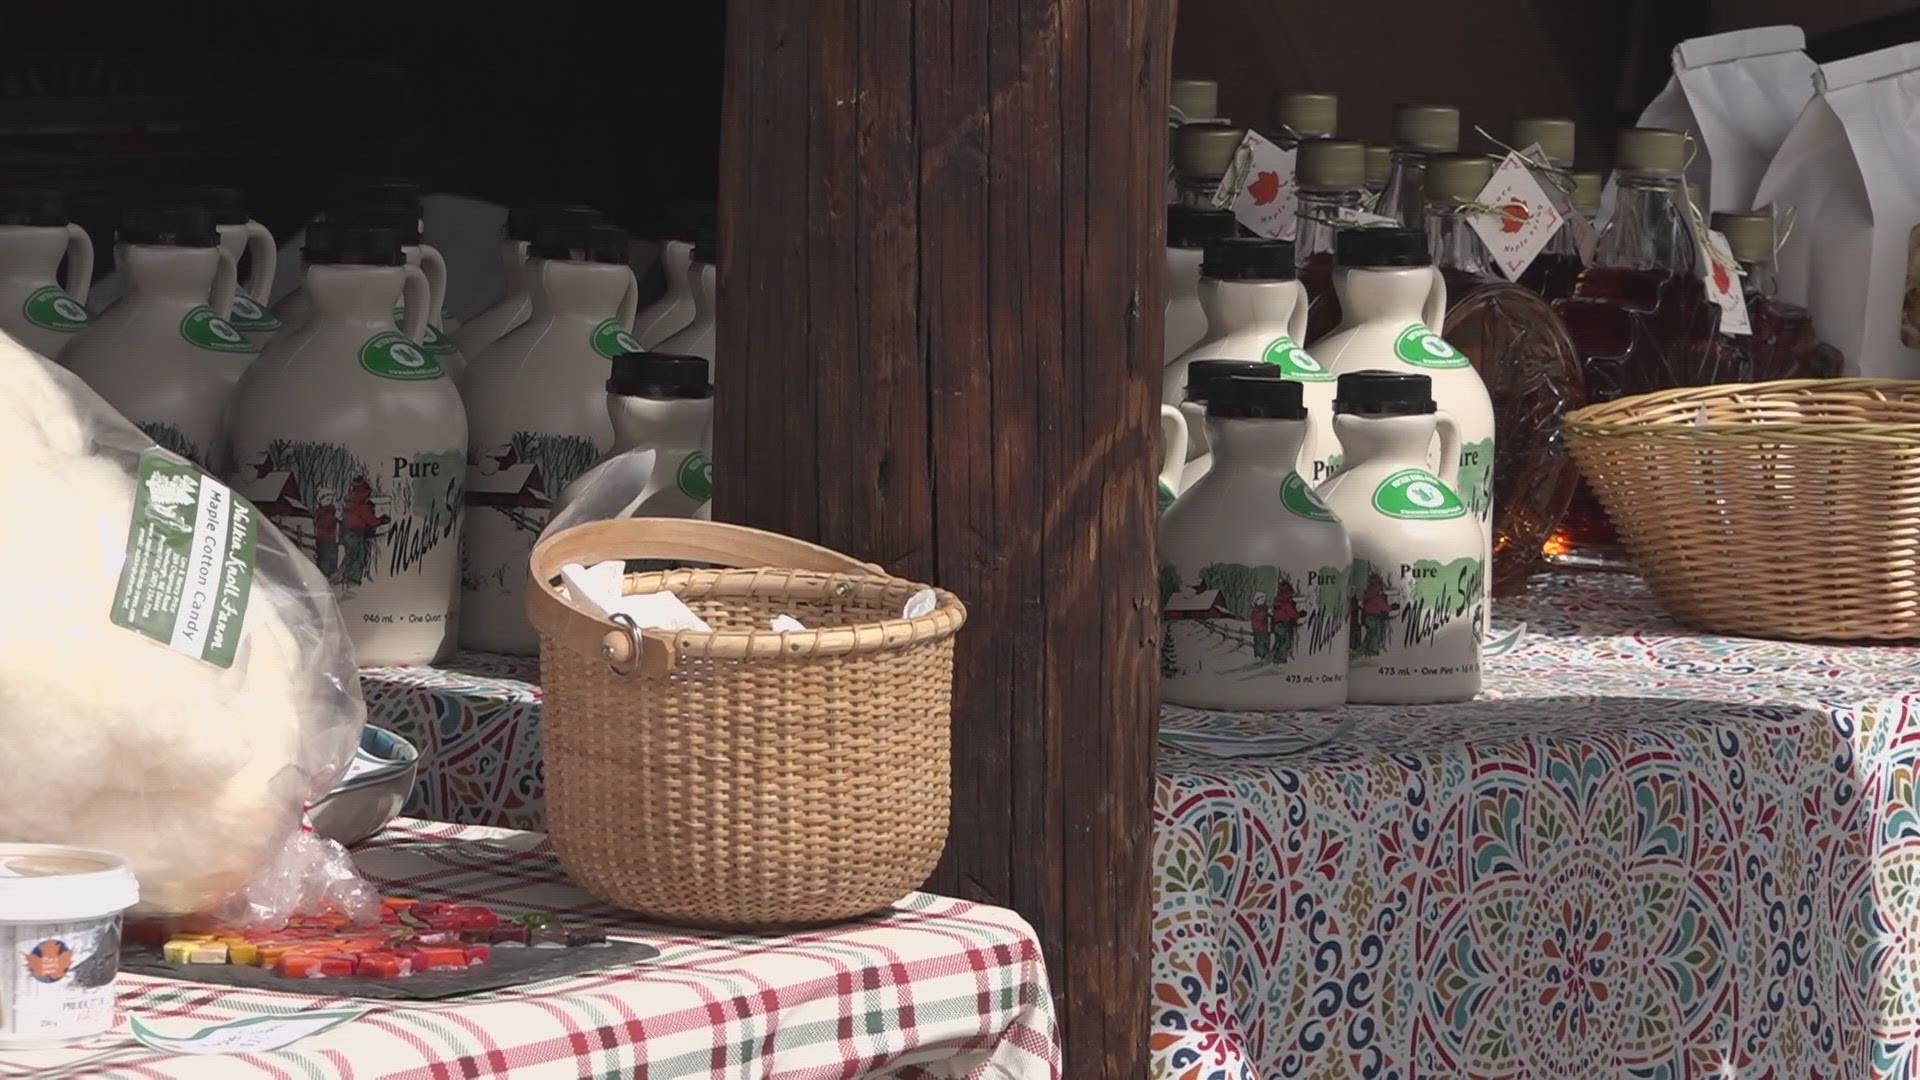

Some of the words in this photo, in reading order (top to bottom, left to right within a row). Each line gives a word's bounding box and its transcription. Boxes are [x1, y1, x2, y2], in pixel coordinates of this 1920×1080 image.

[392, 457, 440, 478] Pure
[206, 489, 222, 532] Maple
[387, 498, 440, 577] Maple
[198, 536, 217, 586] Cotton
[223, 550, 247, 599] Knoll
[1307, 571, 1338, 586] Pure
[1399, 563, 1438, 579] Pure
[182, 591, 208, 641] Candy
[210, 595, 239, 650] Farm
[363, 613, 380, 624] 946
[408, 613, 423, 624] One
[1401, 583, 1452, 649] Maple
[1285, 674, 1301, 684] 473
[1378, 666, 1396, 676] 473
[1421, 666, 1438, 676] One
